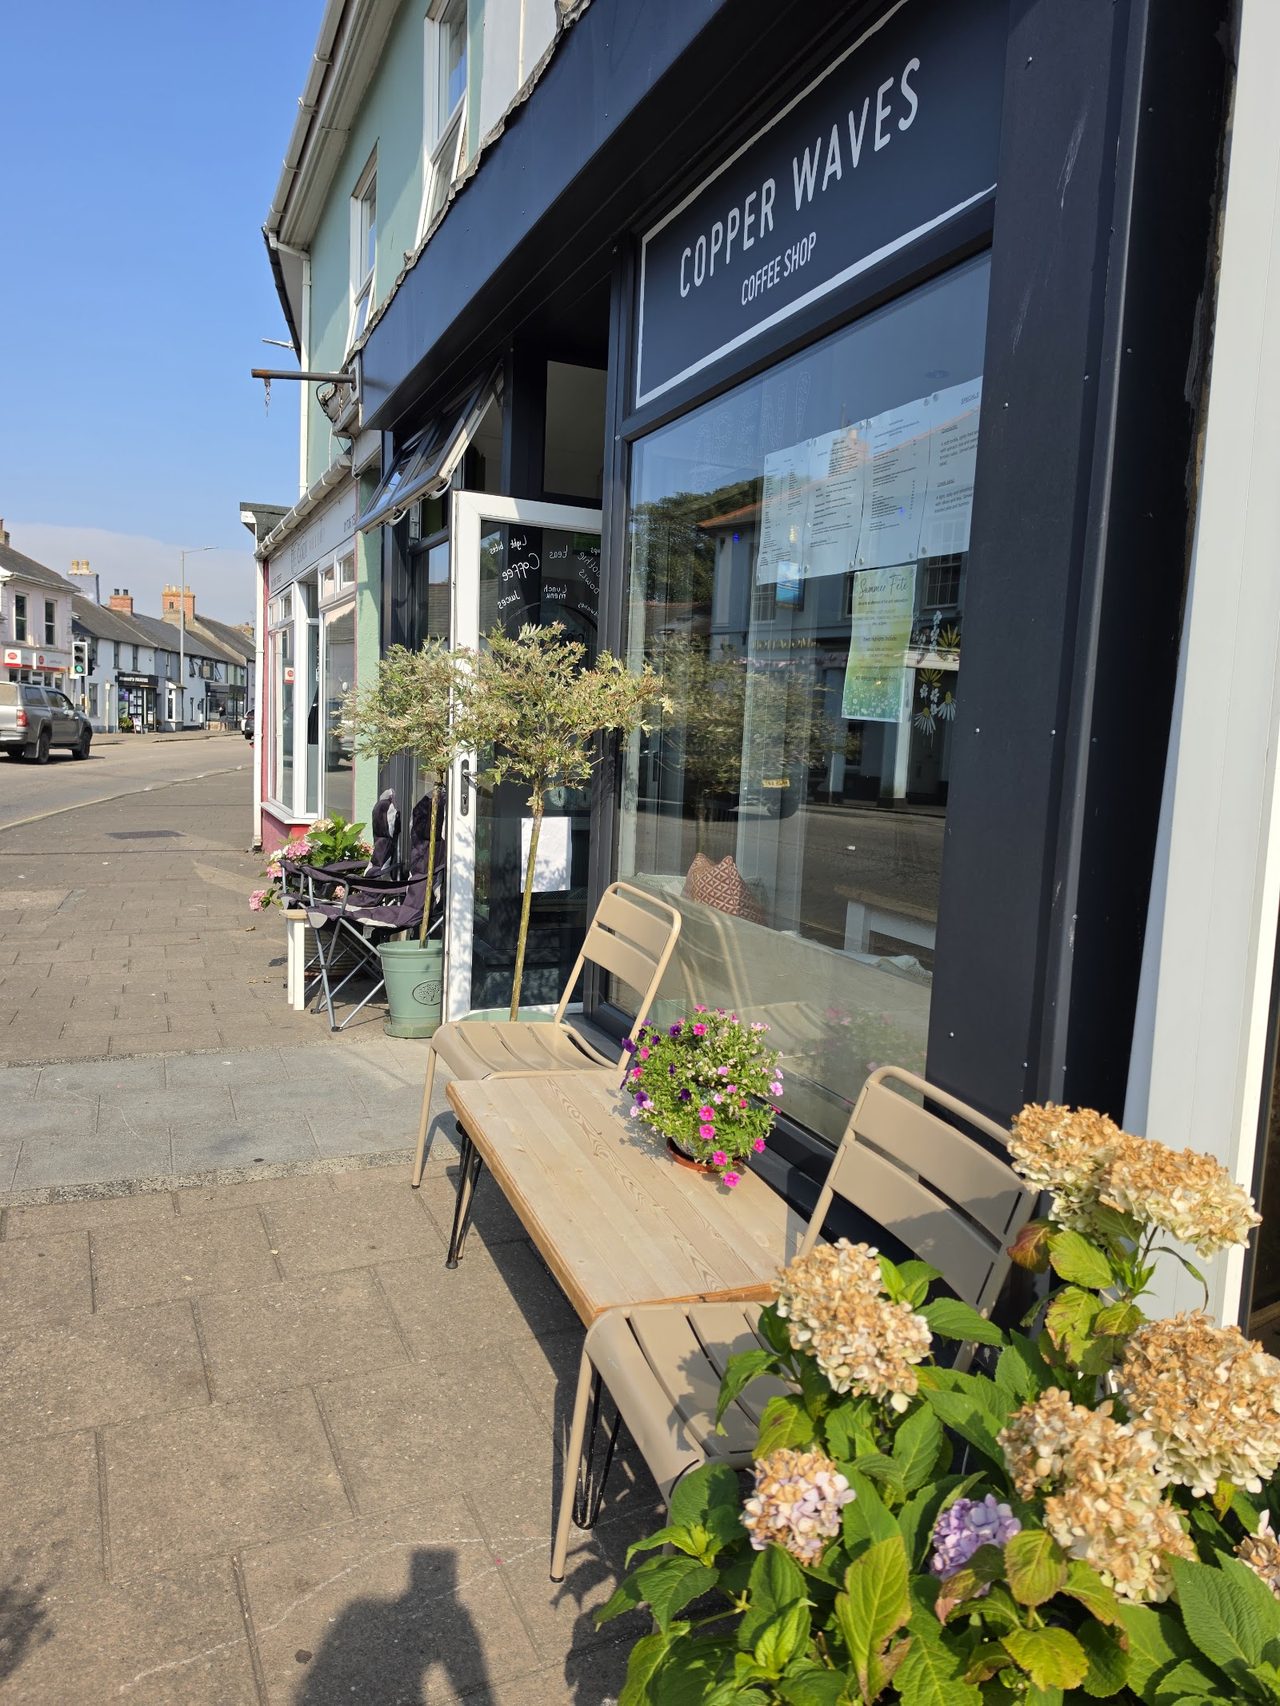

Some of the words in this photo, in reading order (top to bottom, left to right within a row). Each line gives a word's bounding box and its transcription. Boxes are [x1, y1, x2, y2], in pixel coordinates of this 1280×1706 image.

[679, 177, 776, 298] COPPER
[792, 57, 921, 212] WAVES
[741, 254, 781, 306] COFFEE
[783, 231, 817, 277] SHOP
